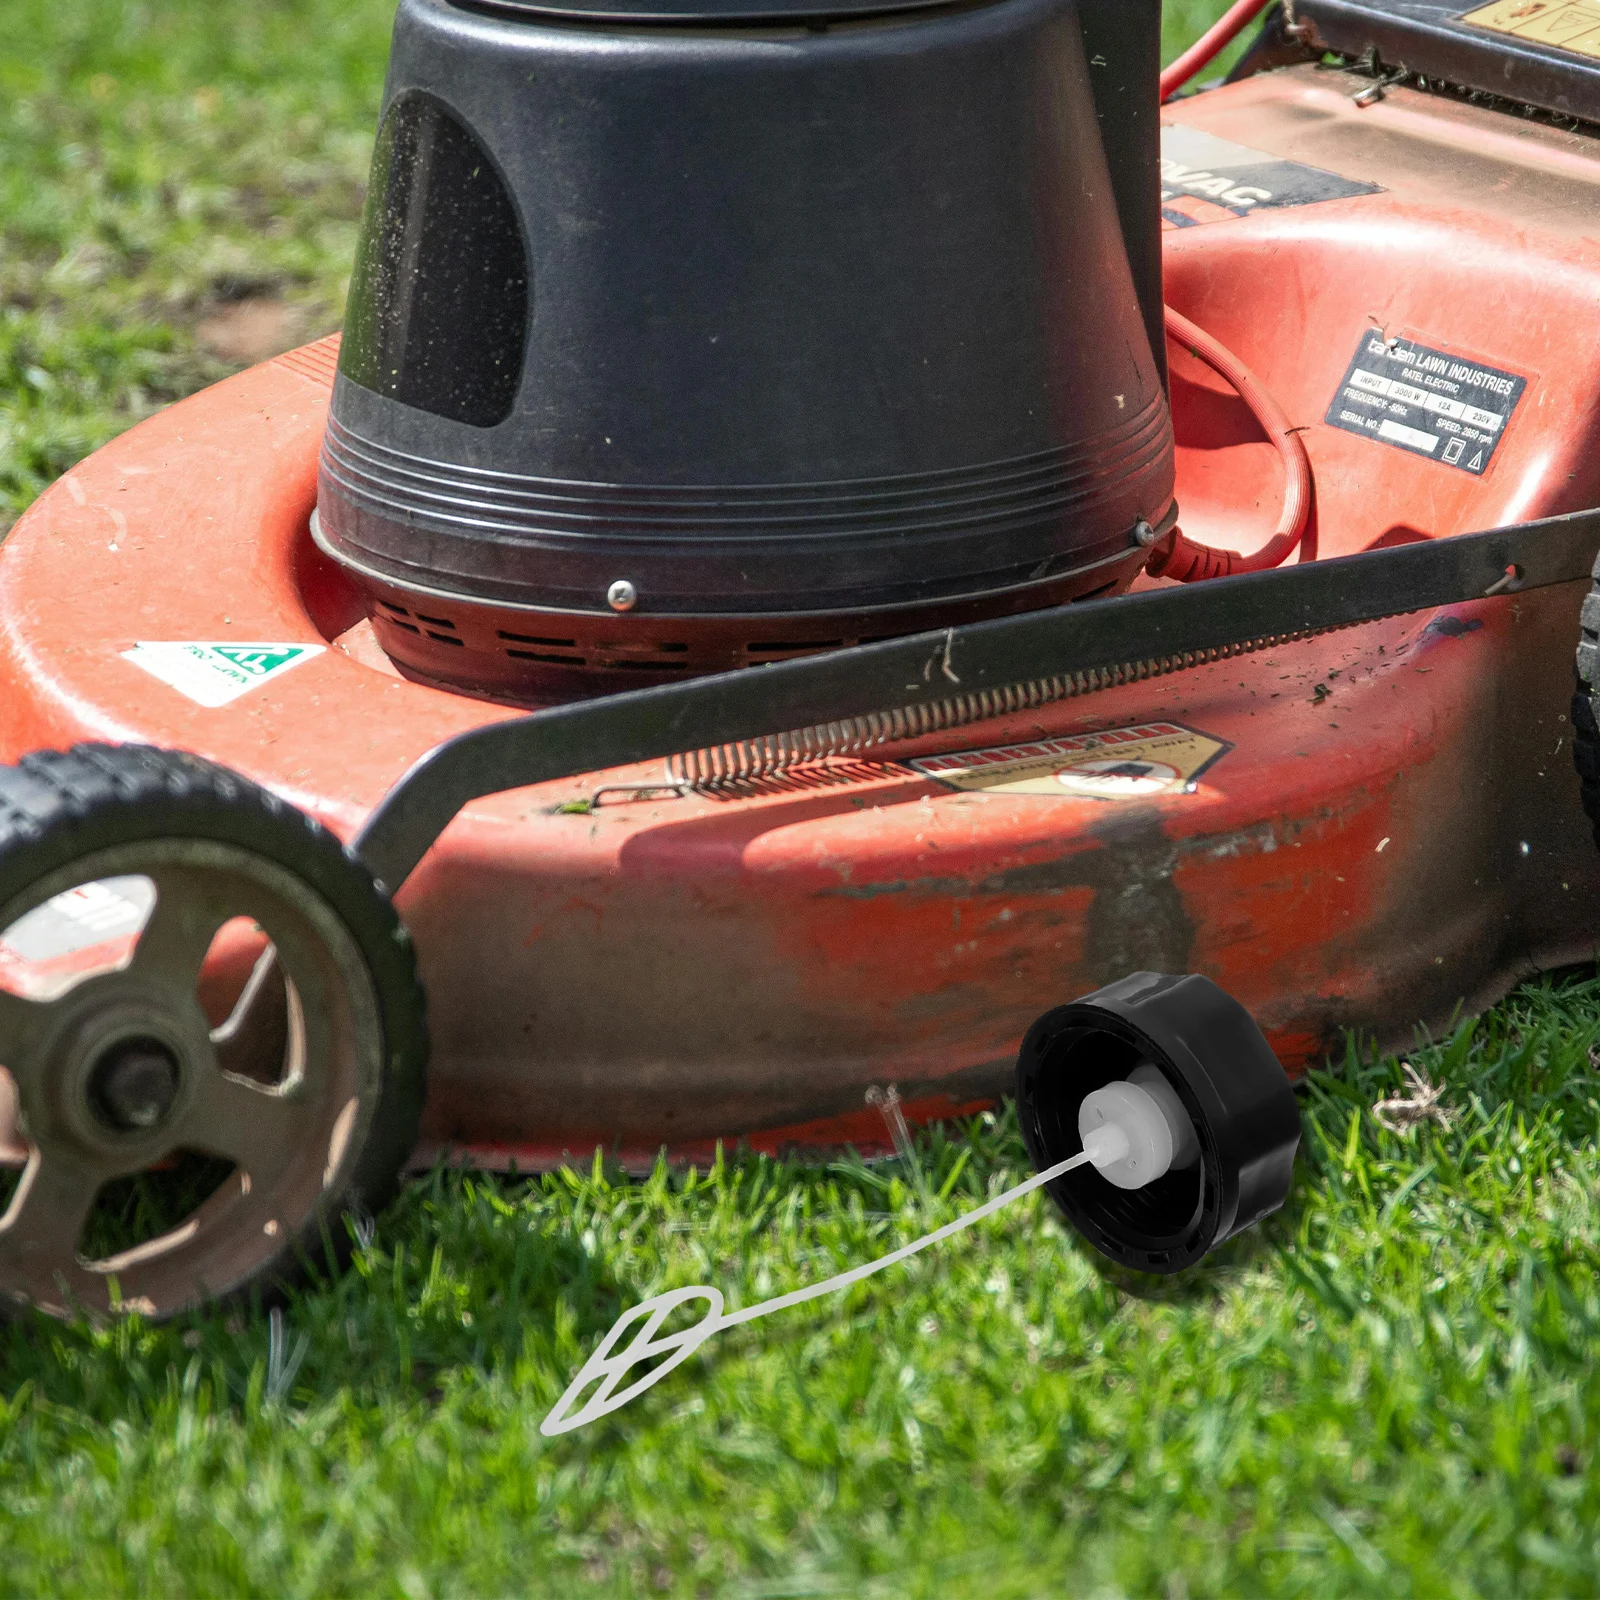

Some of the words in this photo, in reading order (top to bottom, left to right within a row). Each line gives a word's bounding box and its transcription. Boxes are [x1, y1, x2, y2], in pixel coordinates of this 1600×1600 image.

[1402, 368, 1424, 382] RATEL
[1424, 375, 1460, 393] ELECTRIC
[1417, 353, 1449, 374] LAWN
[1449, 364, 1514, 395] INDUSTRIES
[1343, 388, 1388, 409] FREQUENCY:
[1360, 376, 1382, 388] INPUT
[1438, 401, 1451, 411] 12A
[1473, 412, 1492, 424] 230V
[1340, 410, 1365, 425] SERIAL
[1436, 418, 1462, 433] SPEED:
